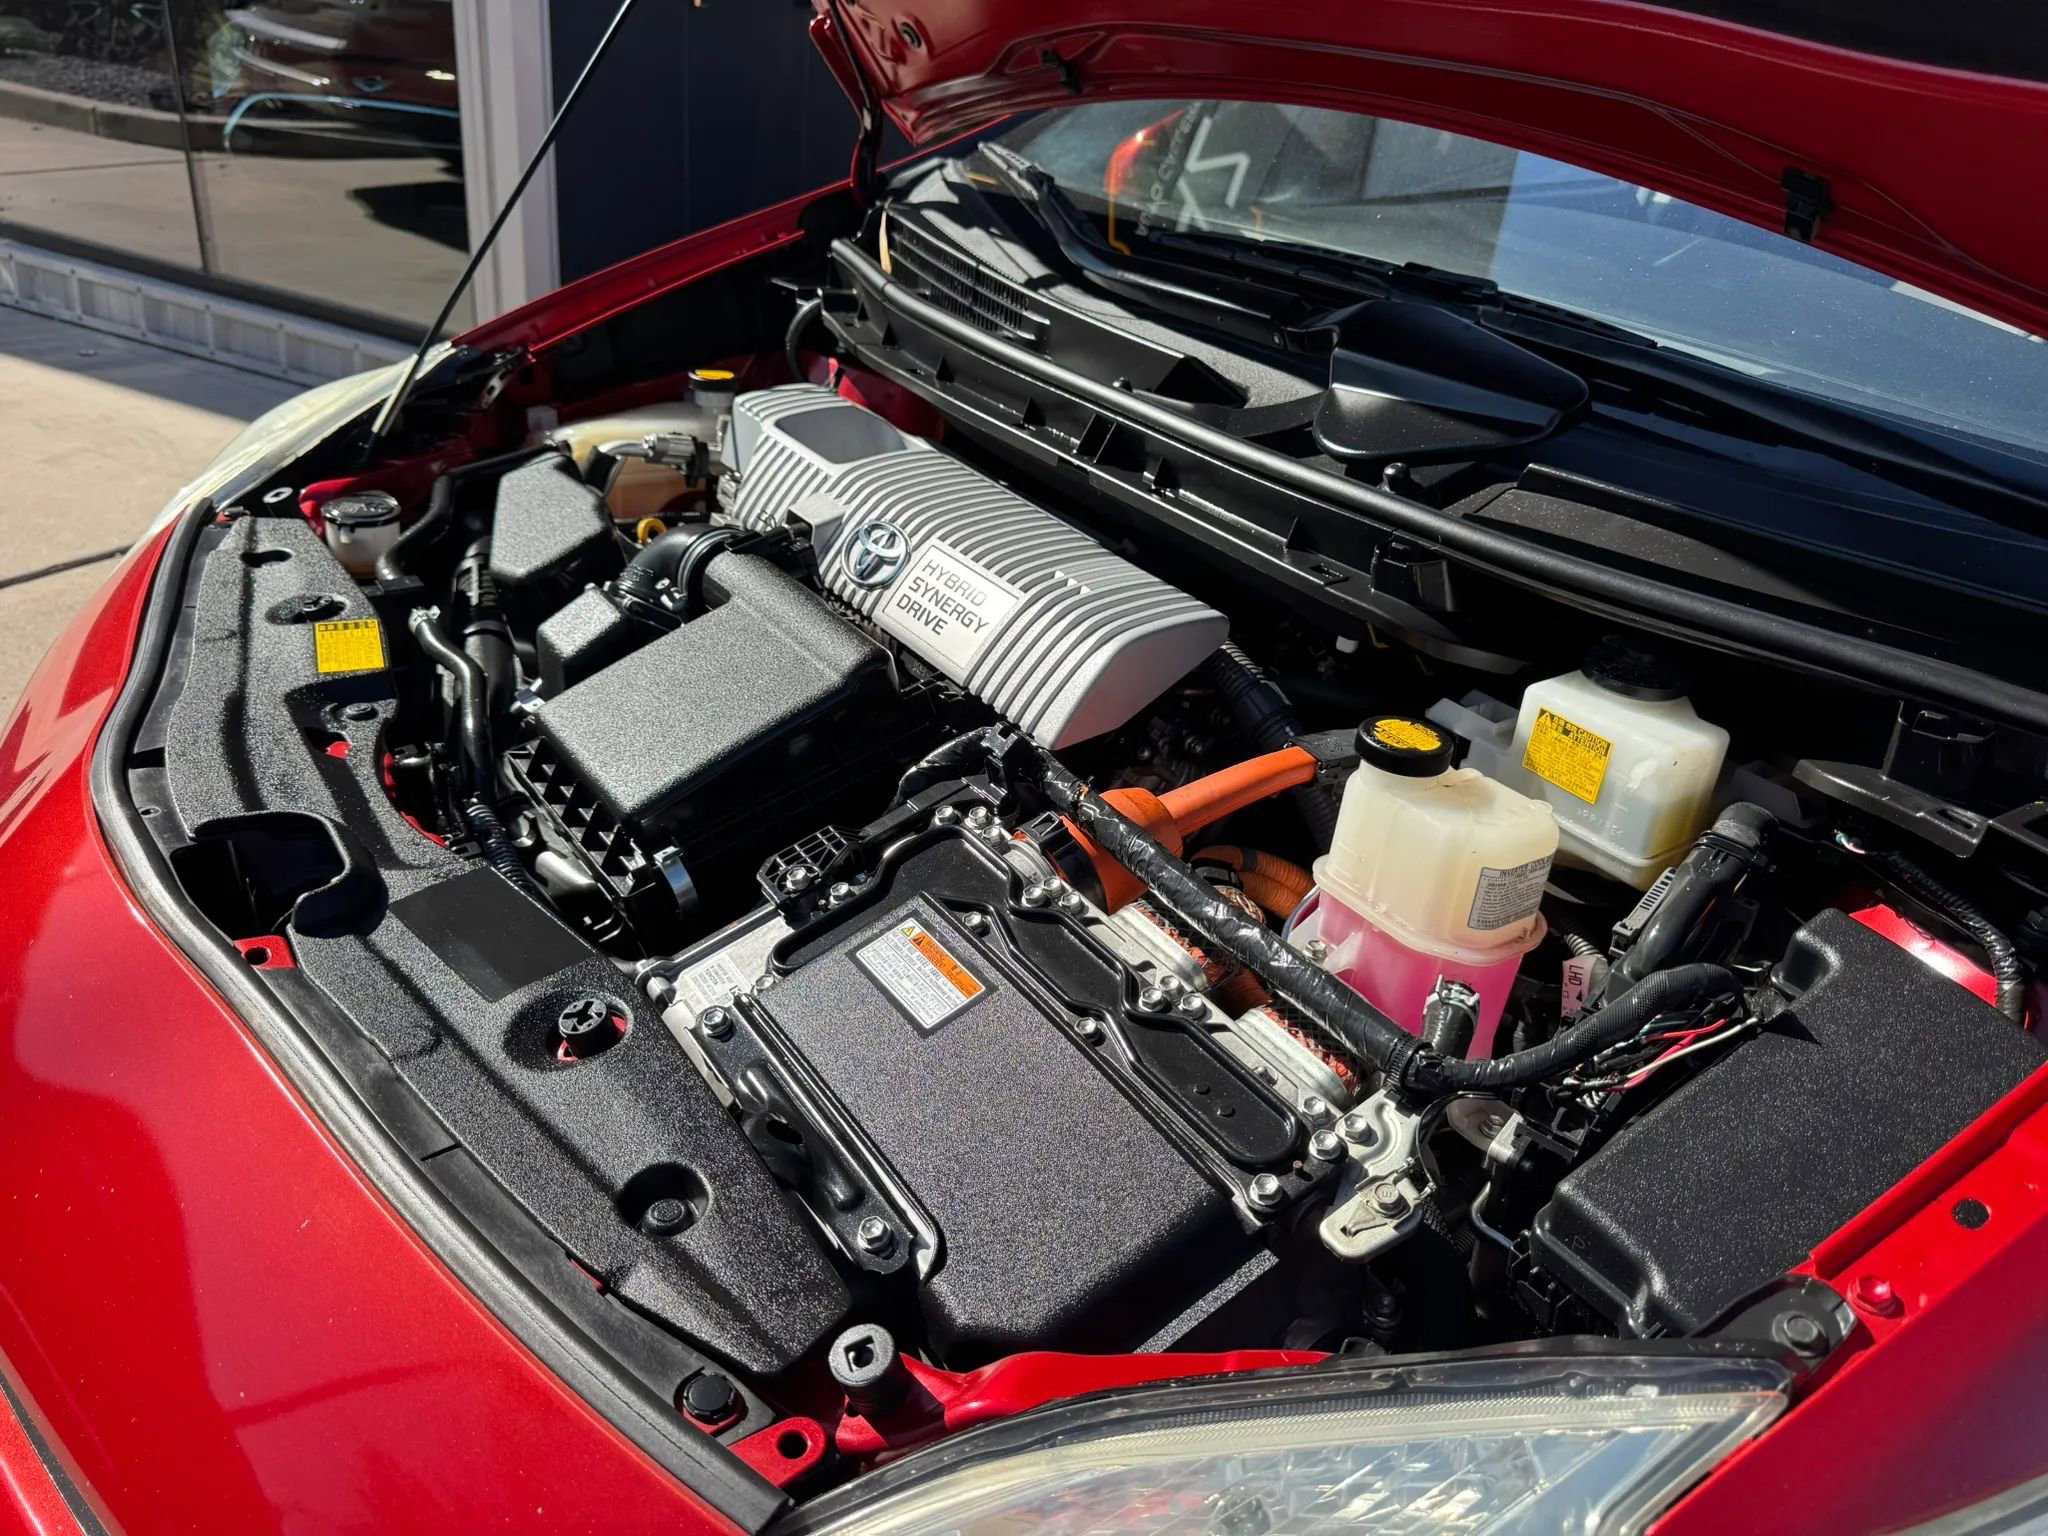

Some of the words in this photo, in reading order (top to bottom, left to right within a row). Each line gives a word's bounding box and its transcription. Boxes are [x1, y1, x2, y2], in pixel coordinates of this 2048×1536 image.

[921, 559, 988, 607] HYBRID
[895, 594, 949, 636] DRIVE
[908, 576, 990, 634] SYNERGY
[1568, 732, 1606, 755] ATTENTION
[1577, 728, 1608, 749] CAUTION
[1568, 964, 1585, 986] LHD
